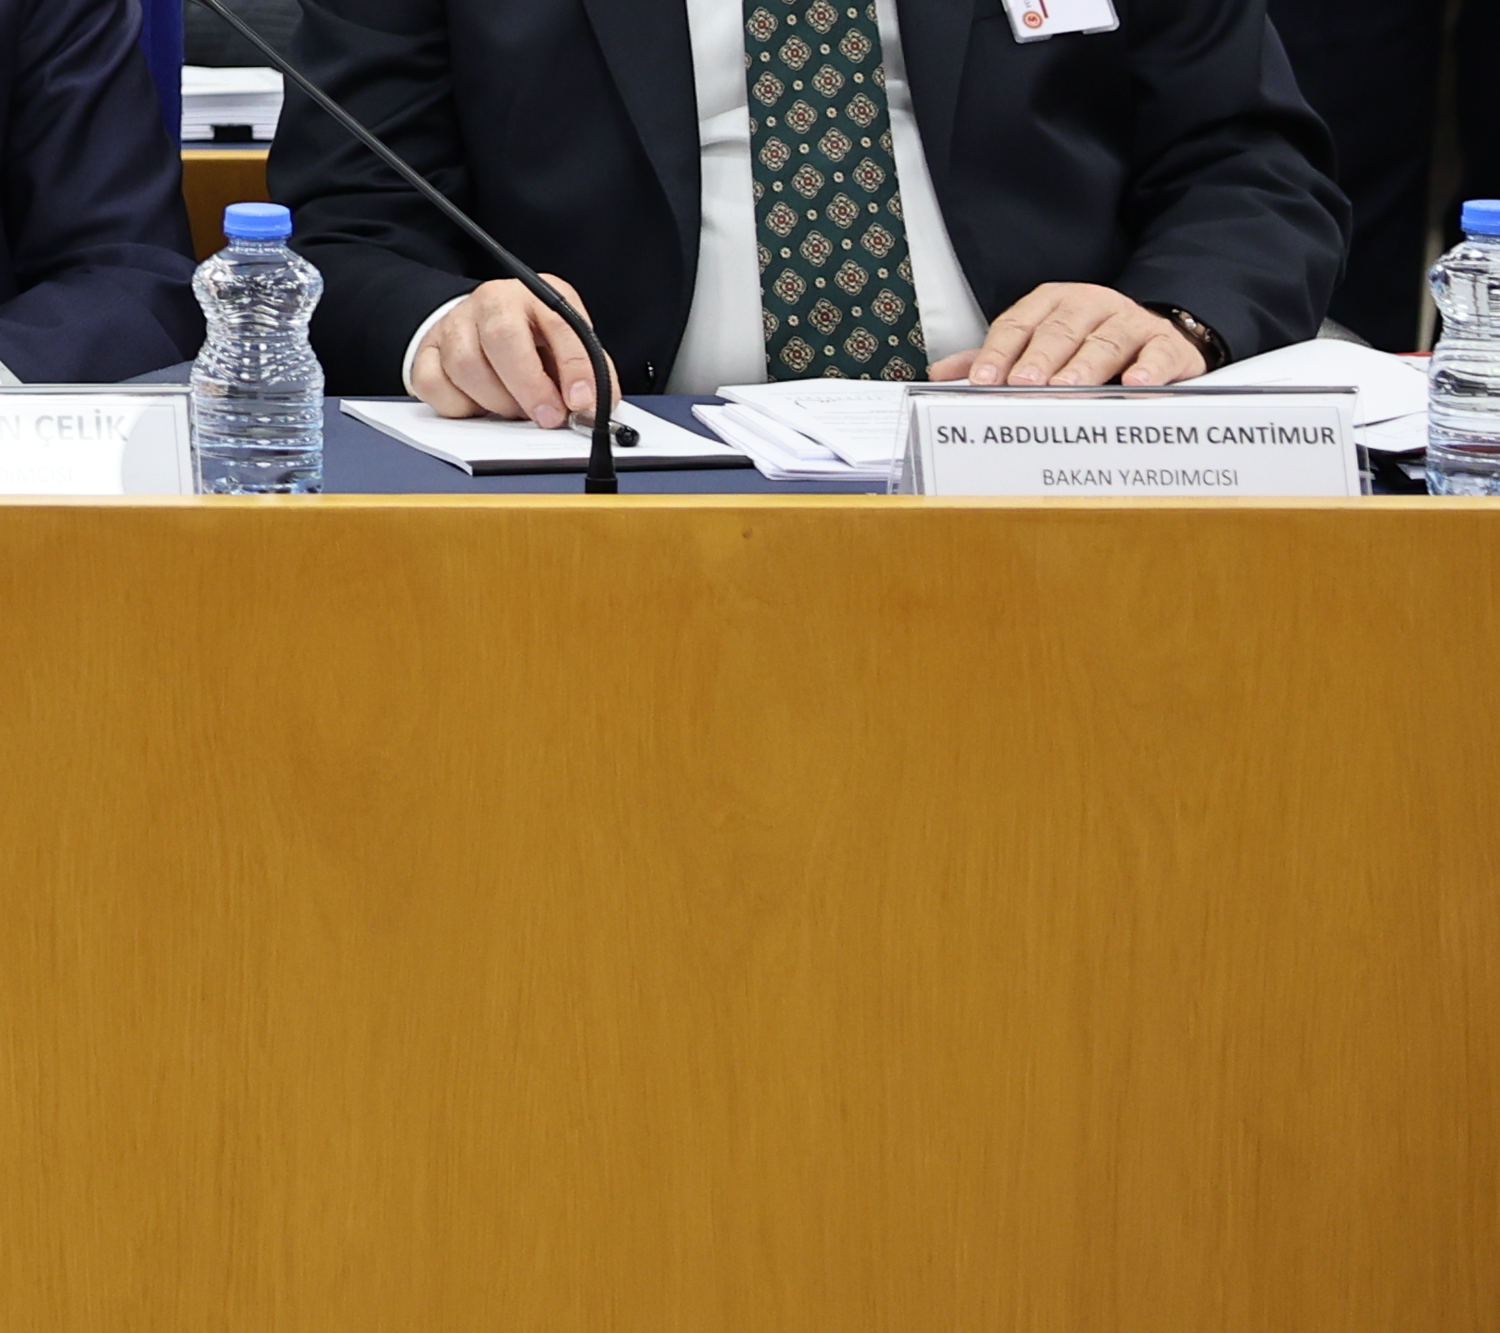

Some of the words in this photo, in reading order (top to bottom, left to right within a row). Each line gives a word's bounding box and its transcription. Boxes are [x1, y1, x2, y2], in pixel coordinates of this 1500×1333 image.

[34, 408, 129, 447] ÇELİK
[936, 425, 975, 444] SN.
[982, 425, 1108, 444] ABDULLAH
[1115, 426, 1199, 445] ERDEM
[1206, 421, 1336, 445] CANTİMUR
[1042, 468, 1113, 486] BAKAN
[1118, 468, 1239, 487] YARDIMCISI
